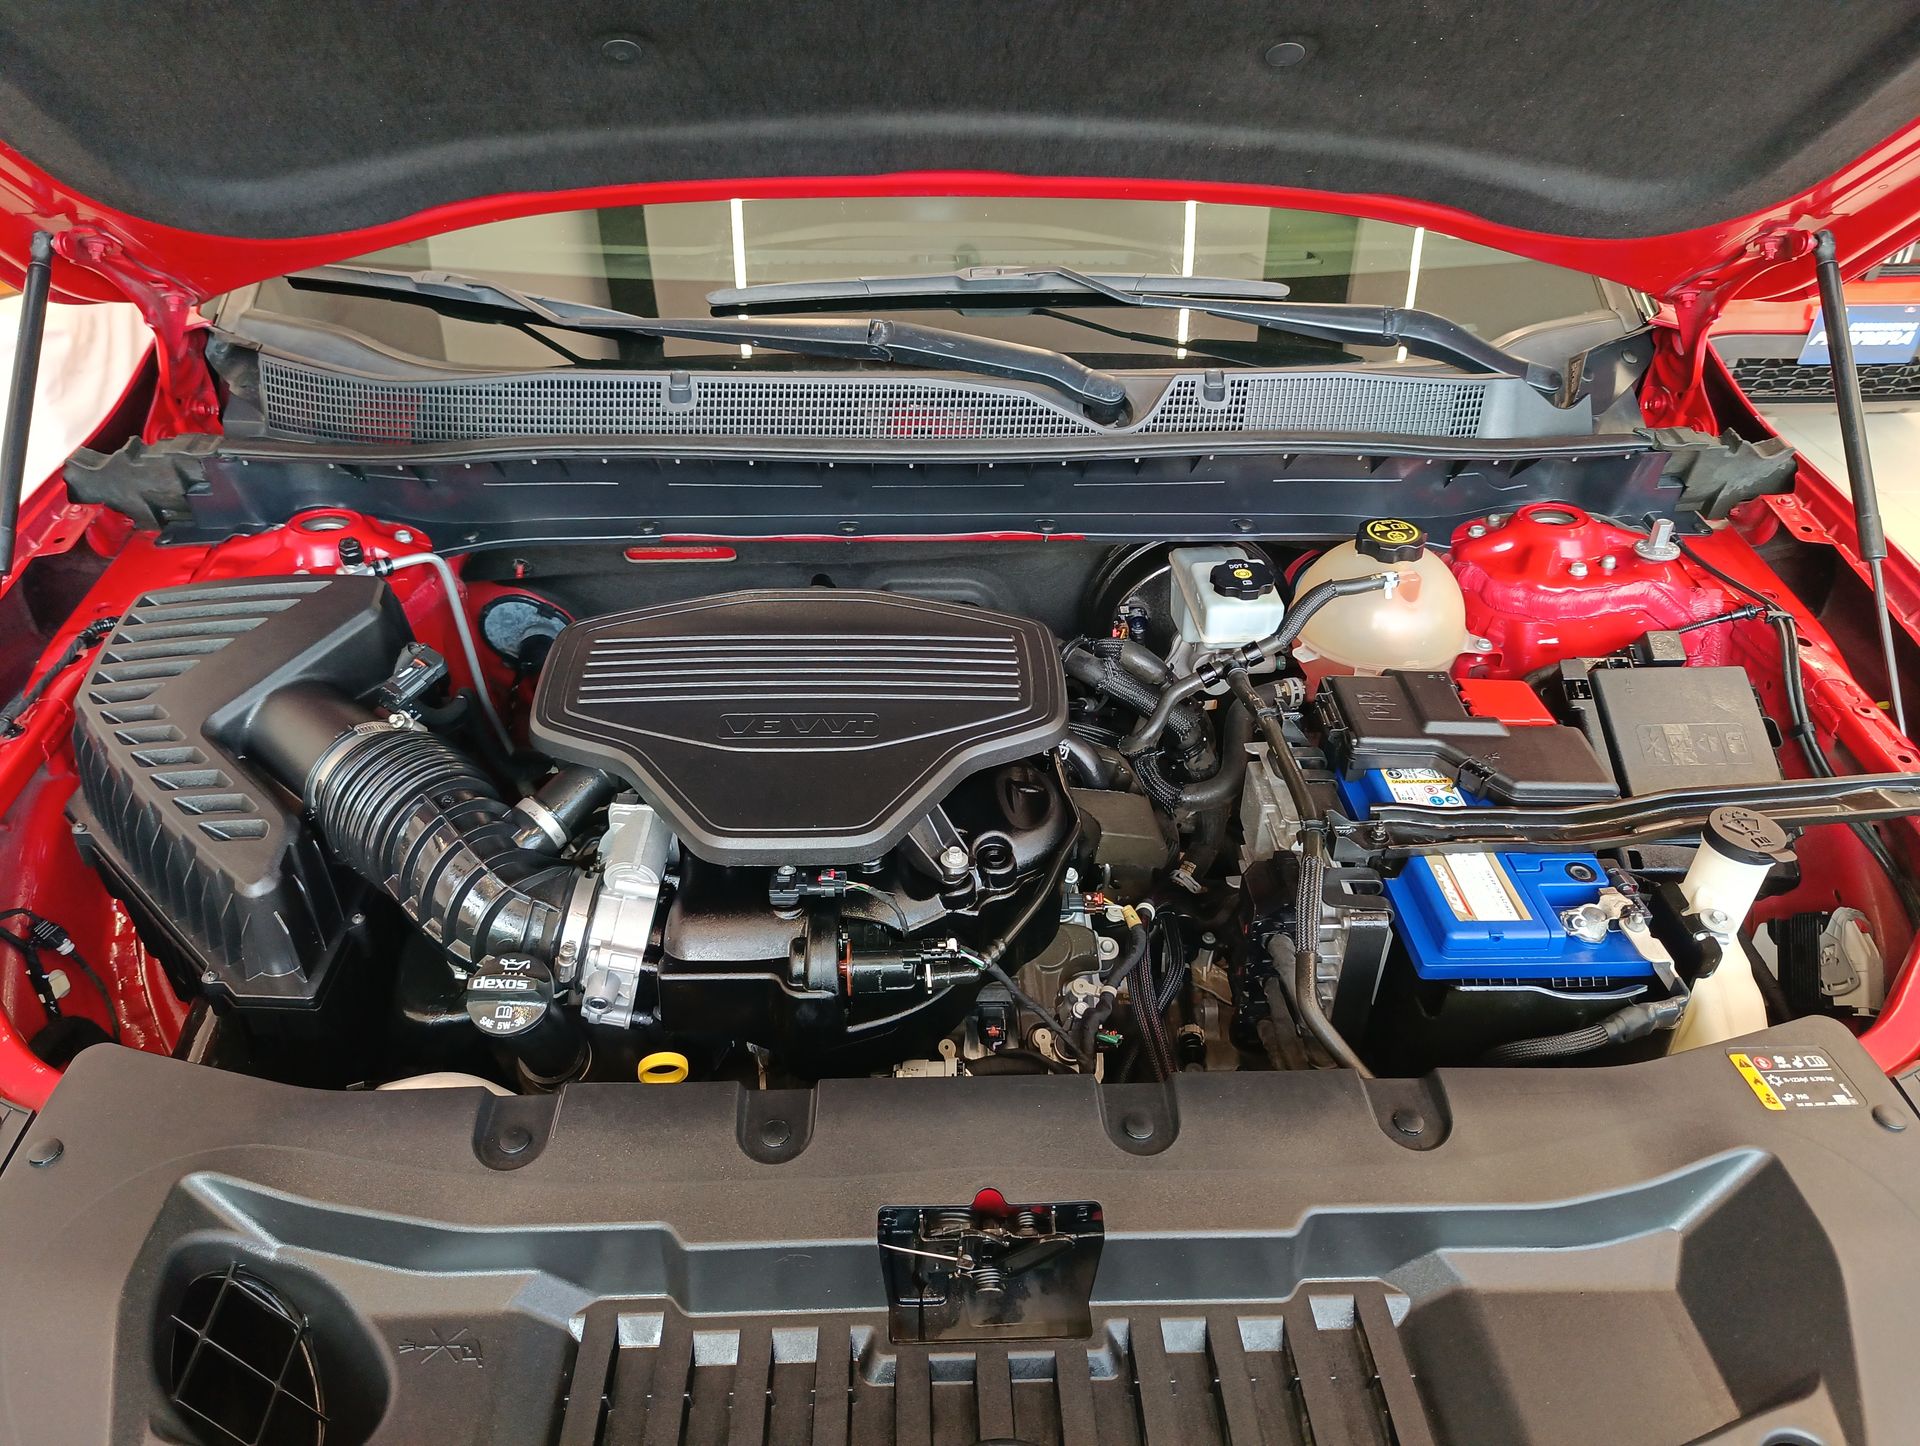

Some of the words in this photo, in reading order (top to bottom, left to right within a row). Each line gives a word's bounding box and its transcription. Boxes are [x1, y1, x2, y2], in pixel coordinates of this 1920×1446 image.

[473, 976, 530, 989] dexos
[479, 1016, 495, 1029] SAE
[496, 1017, 527, 1030] 5W-30
